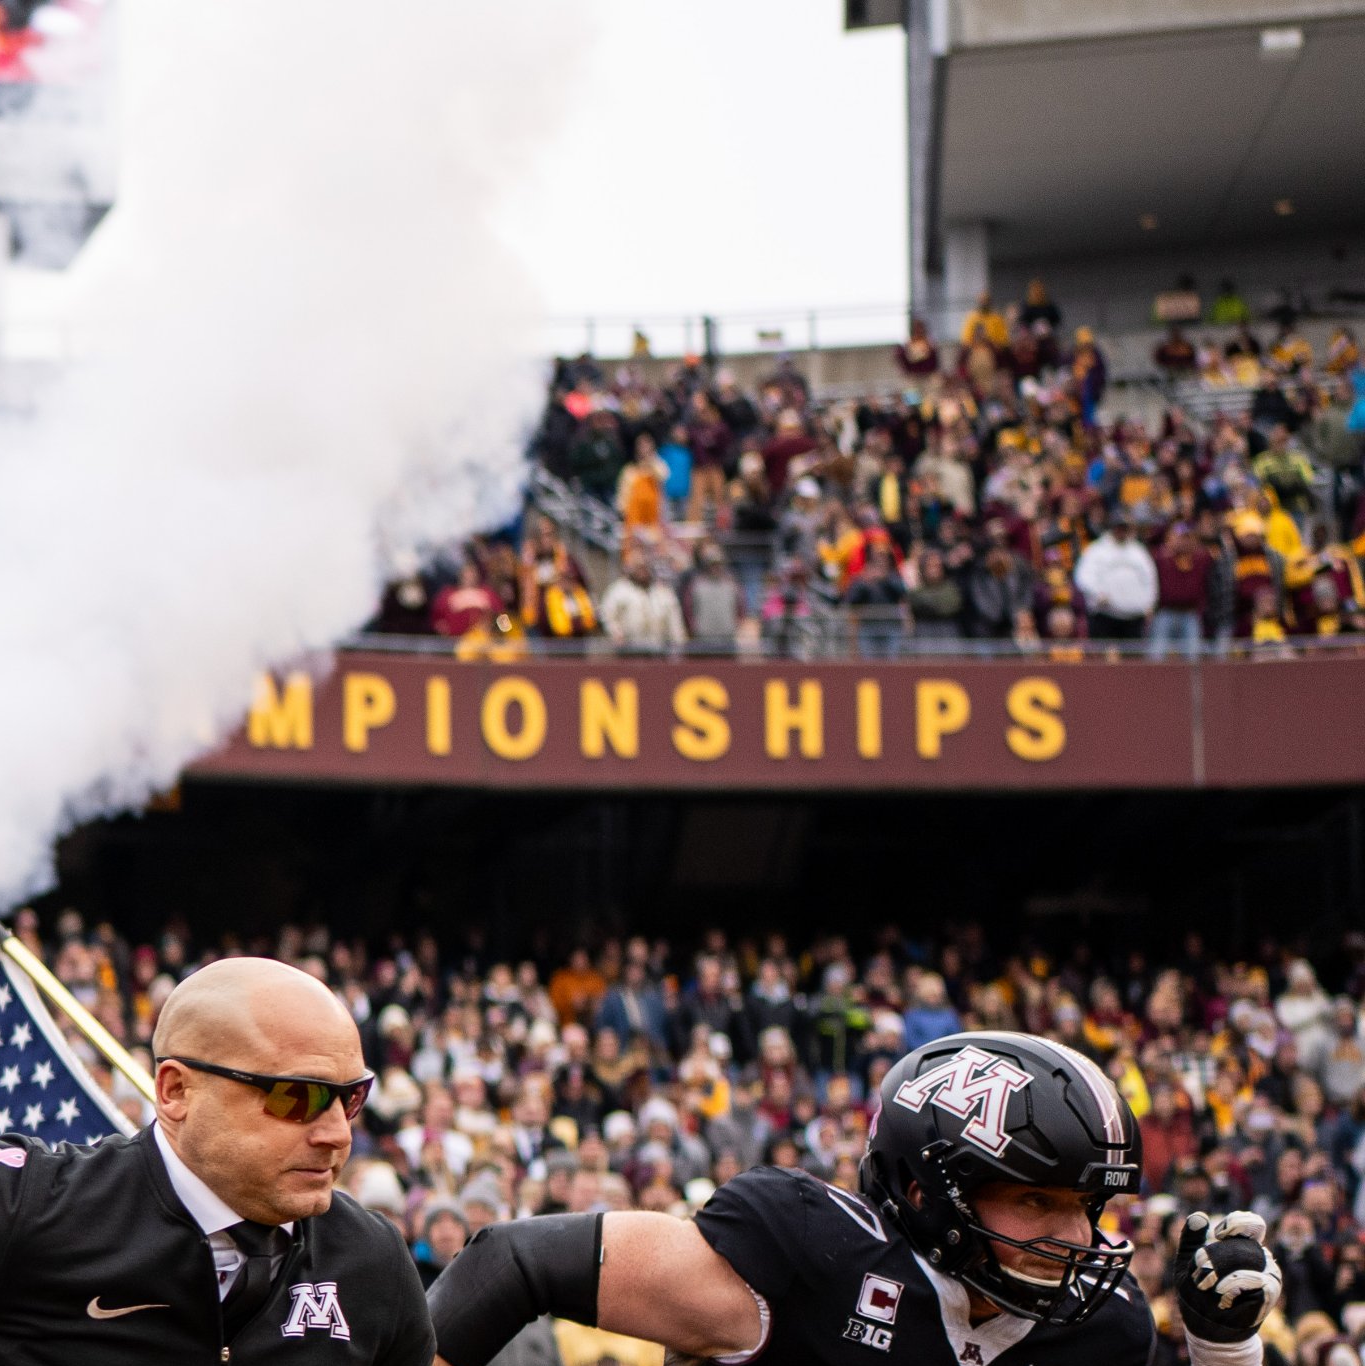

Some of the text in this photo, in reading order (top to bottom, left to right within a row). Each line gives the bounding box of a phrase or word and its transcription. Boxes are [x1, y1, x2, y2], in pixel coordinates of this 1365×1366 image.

[247, 670, 1069, 764] MPIONSHIPS
[1104, 1171, 1130, 1187] ROW
[280, 1280, 351, 1341] M
